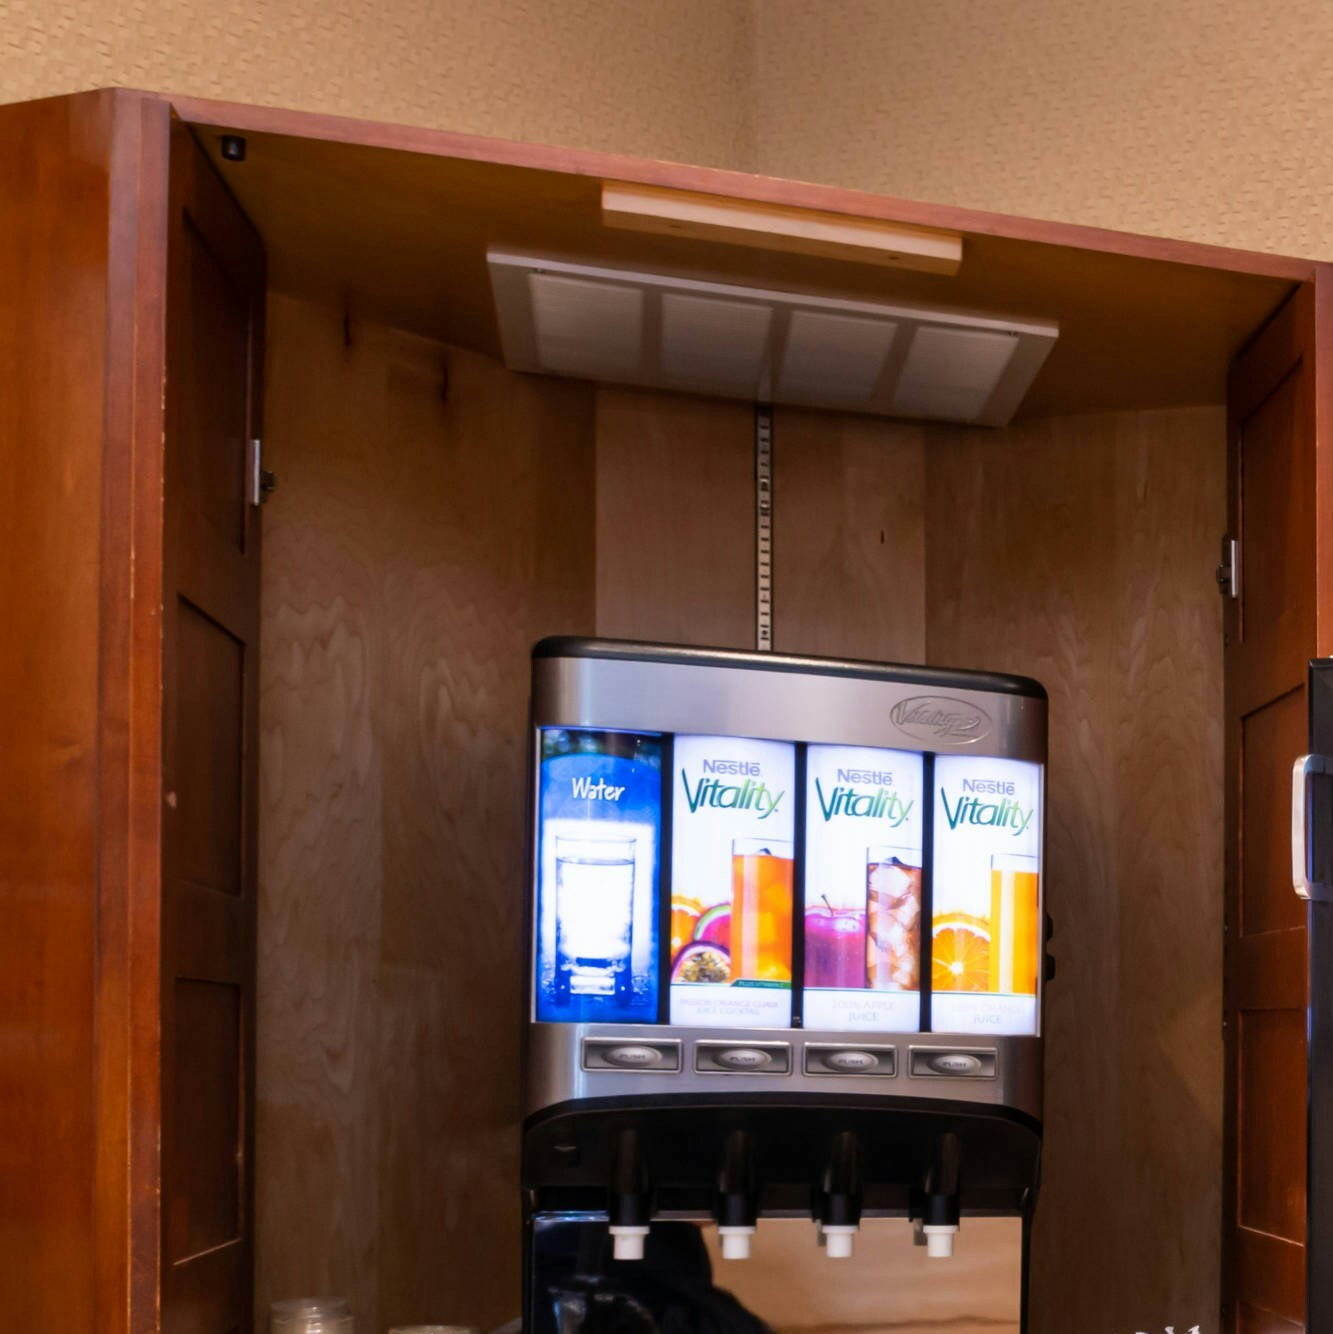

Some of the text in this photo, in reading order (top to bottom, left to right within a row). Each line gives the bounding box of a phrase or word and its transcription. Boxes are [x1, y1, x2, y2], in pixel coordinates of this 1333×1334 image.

[572, 777, 625, 801] Water
[682, 768, 785, 819] Vitality
[815, 776, 914, 828] Vitality
[941, 786, 1033, 836] Vitality
[849, 1011, 879, 1022] JUICE
